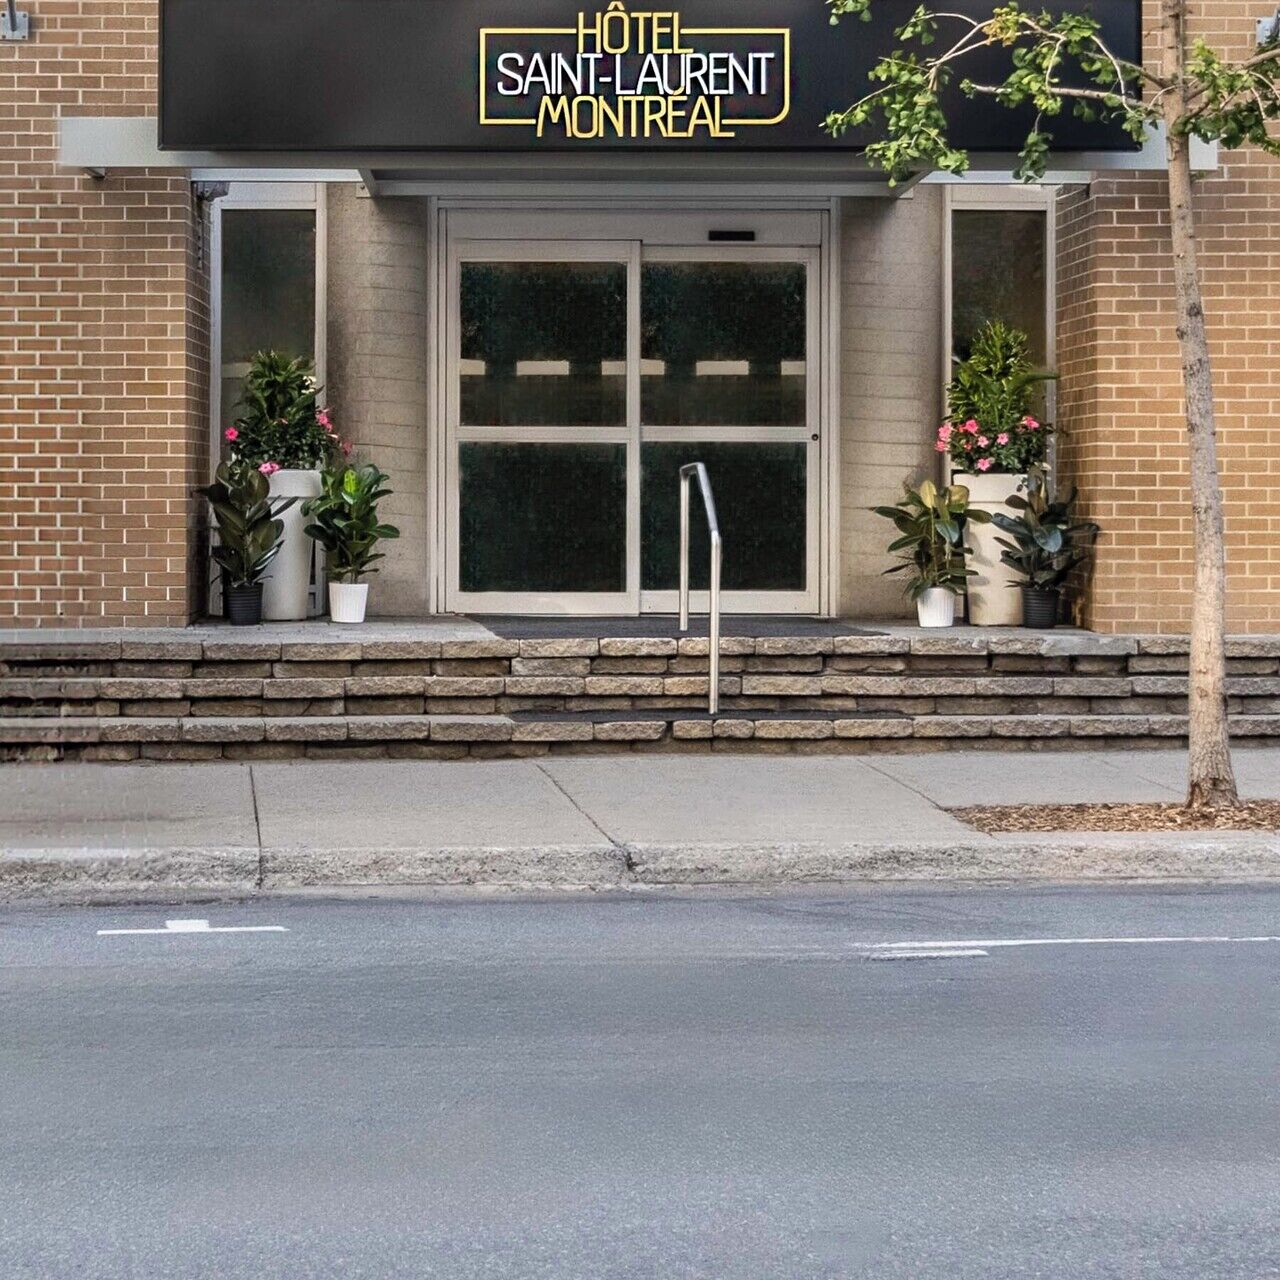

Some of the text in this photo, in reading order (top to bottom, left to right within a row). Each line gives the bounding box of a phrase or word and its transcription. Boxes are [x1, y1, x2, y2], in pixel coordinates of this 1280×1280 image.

[577, 0, 694, 55] HÔTEL
[496, 52, 775, 96] SAINT-LAURENT
[535, 86, 736, 138] MONTRÉAL
